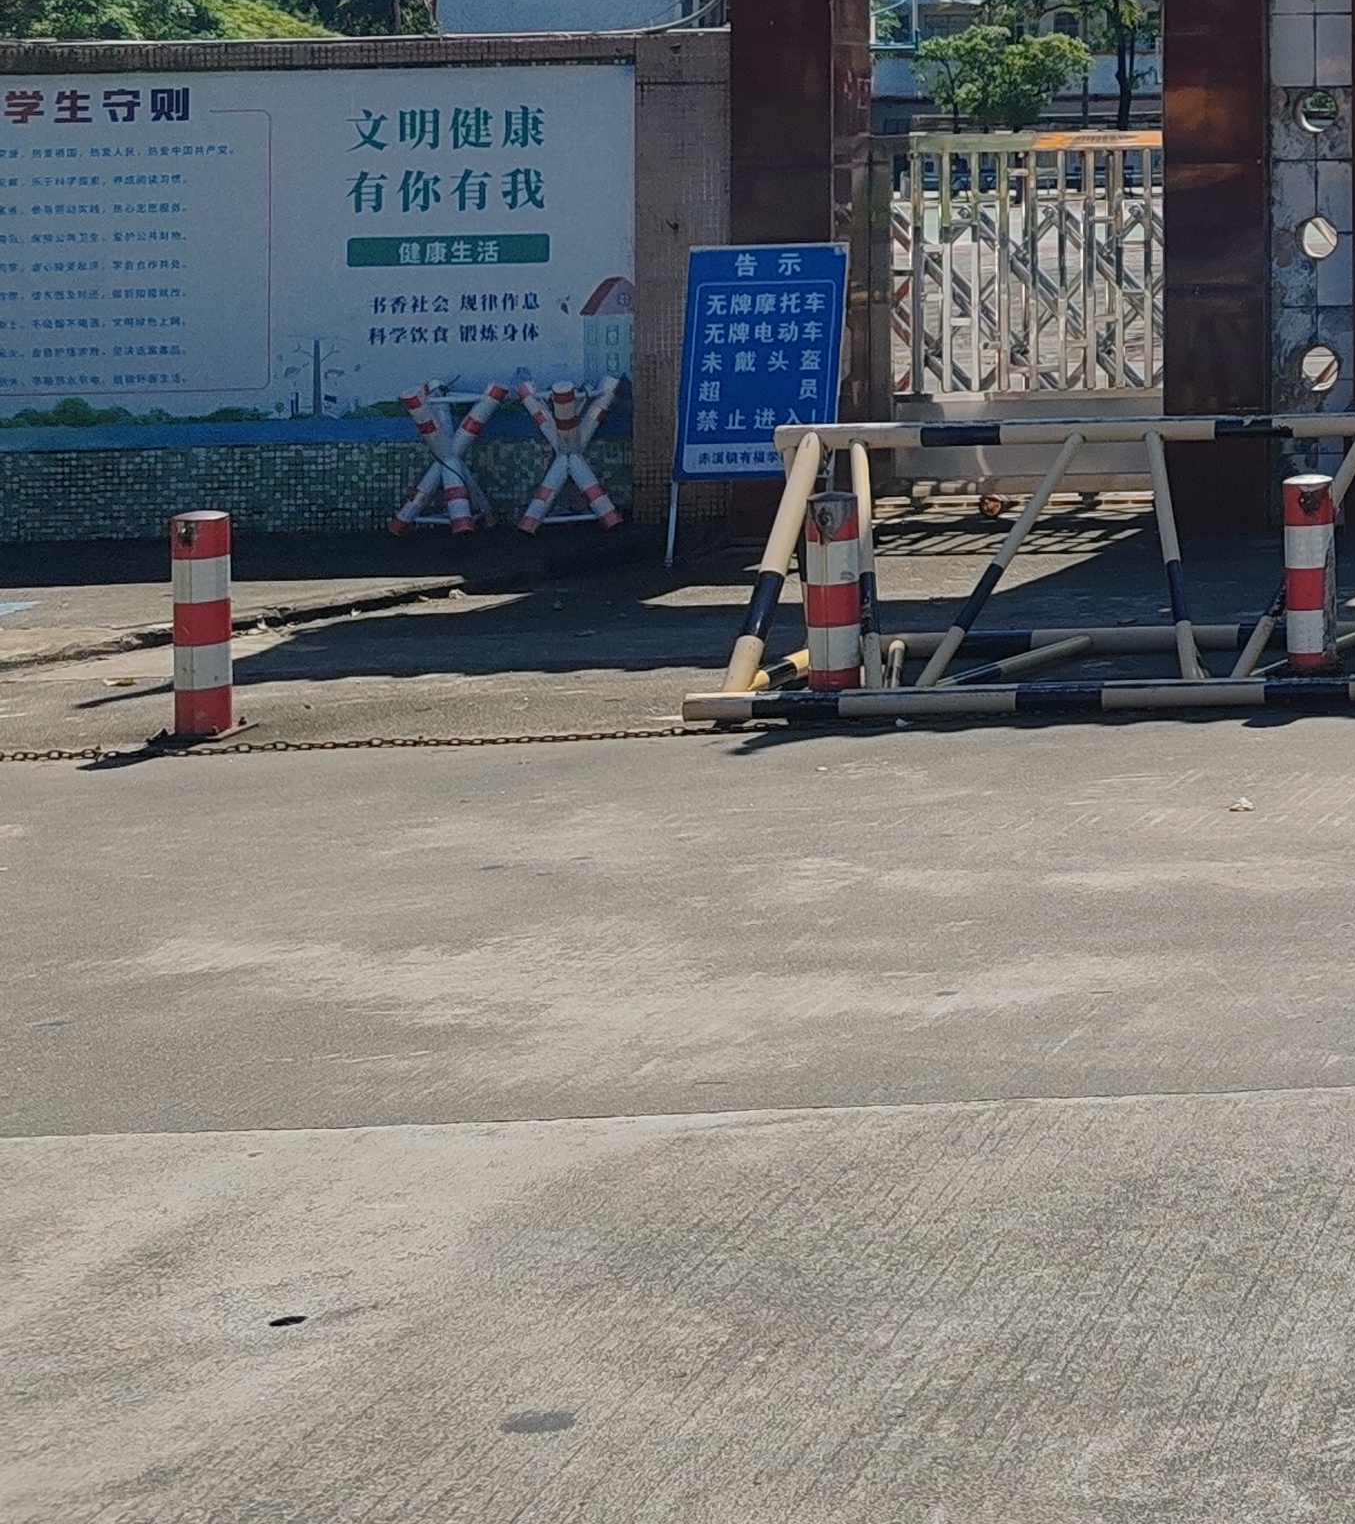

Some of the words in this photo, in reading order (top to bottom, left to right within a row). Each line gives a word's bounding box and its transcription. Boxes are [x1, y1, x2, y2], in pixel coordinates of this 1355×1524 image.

[4, 87, 190, 125] 学生守则
[345, 105, 546, 153] 文明健康
[345, 167, 546, 214] 有你有我
[399, 239, 500, 264] 健康生活
[735, 253, 801, 277] 告示
[369, 294, 450, 315] 书香社会
[459, 291, 540, 312] 规律作息
[706, 292, 826, 316] 无牌摩托车
[368, 326, 450, 346] 科学饮食
[459, 323, 540, 343] 锻炼身体
[703, 320, 824, 344] 无牌电动车
[701, 348, 822, 373] 未戴头盔
[699, 450, 784, 466] 赤溪镇有福学
